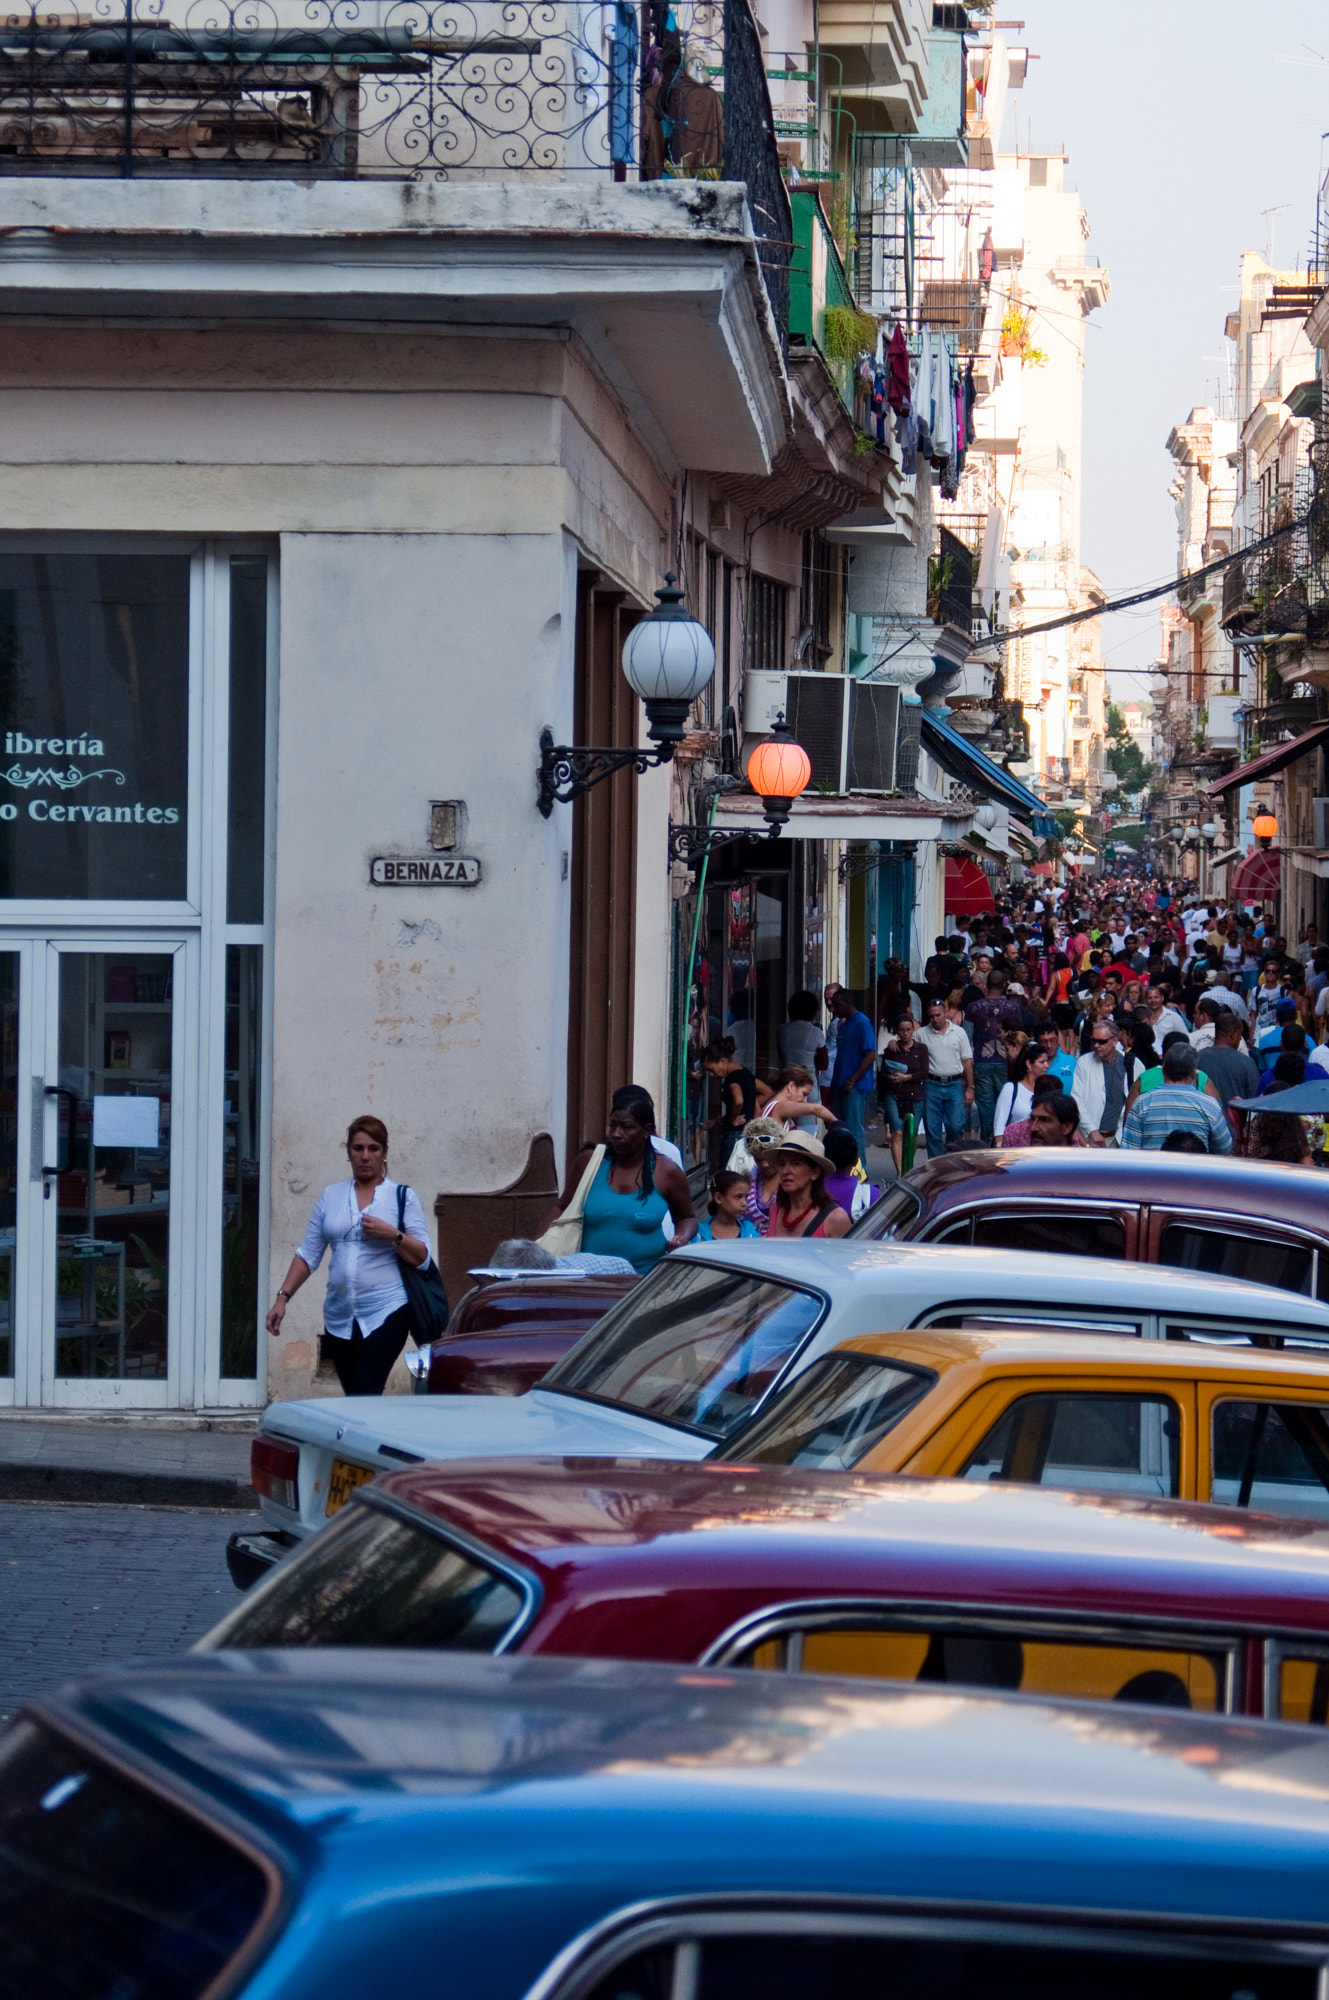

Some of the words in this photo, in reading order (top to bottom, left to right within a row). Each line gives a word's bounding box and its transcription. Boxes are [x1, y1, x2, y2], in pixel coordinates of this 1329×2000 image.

[5, 731, 105, 756] ibrería
[28, 800, 179, 824] Cervantes
[384, 862, 468, 880] BERNAZA
